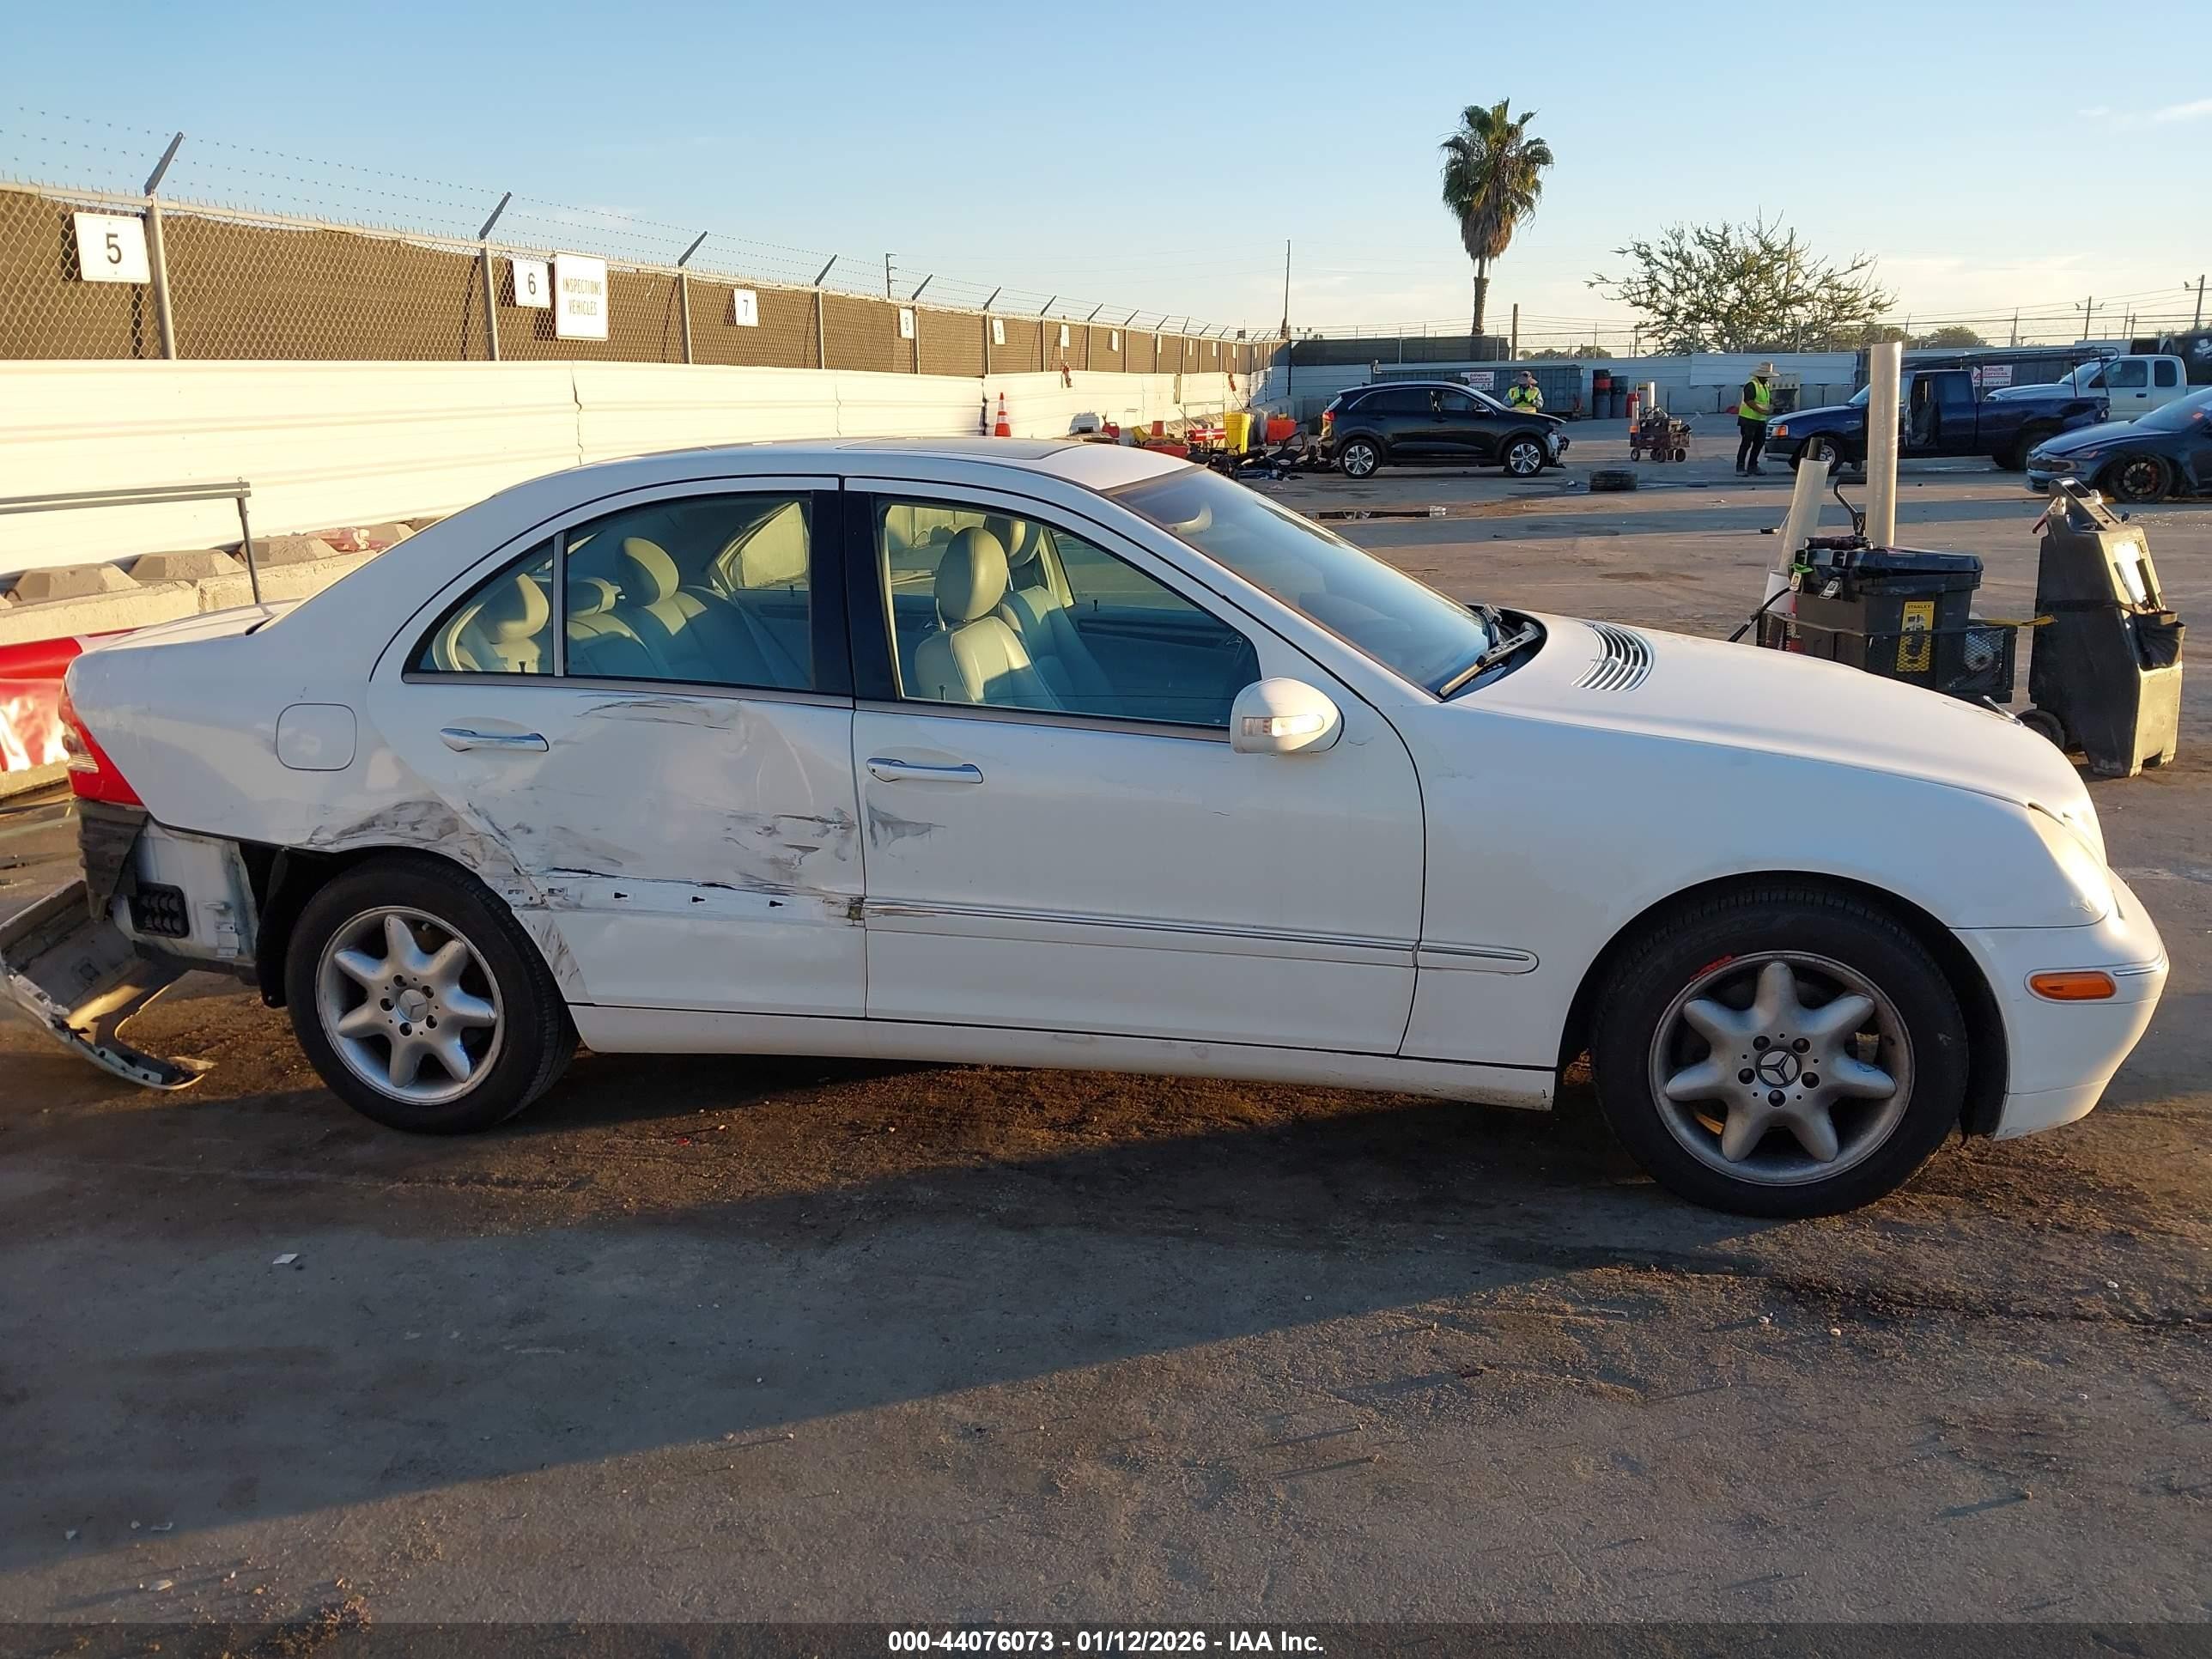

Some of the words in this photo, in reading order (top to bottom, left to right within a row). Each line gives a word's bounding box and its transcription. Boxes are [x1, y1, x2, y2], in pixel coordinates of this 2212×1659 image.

[106, 233, 122, 264] 5
[527, 272, 537, 295] 6
[568, 299, 598, 316] VEHICLES
[743, 299, 749, 317] 7
